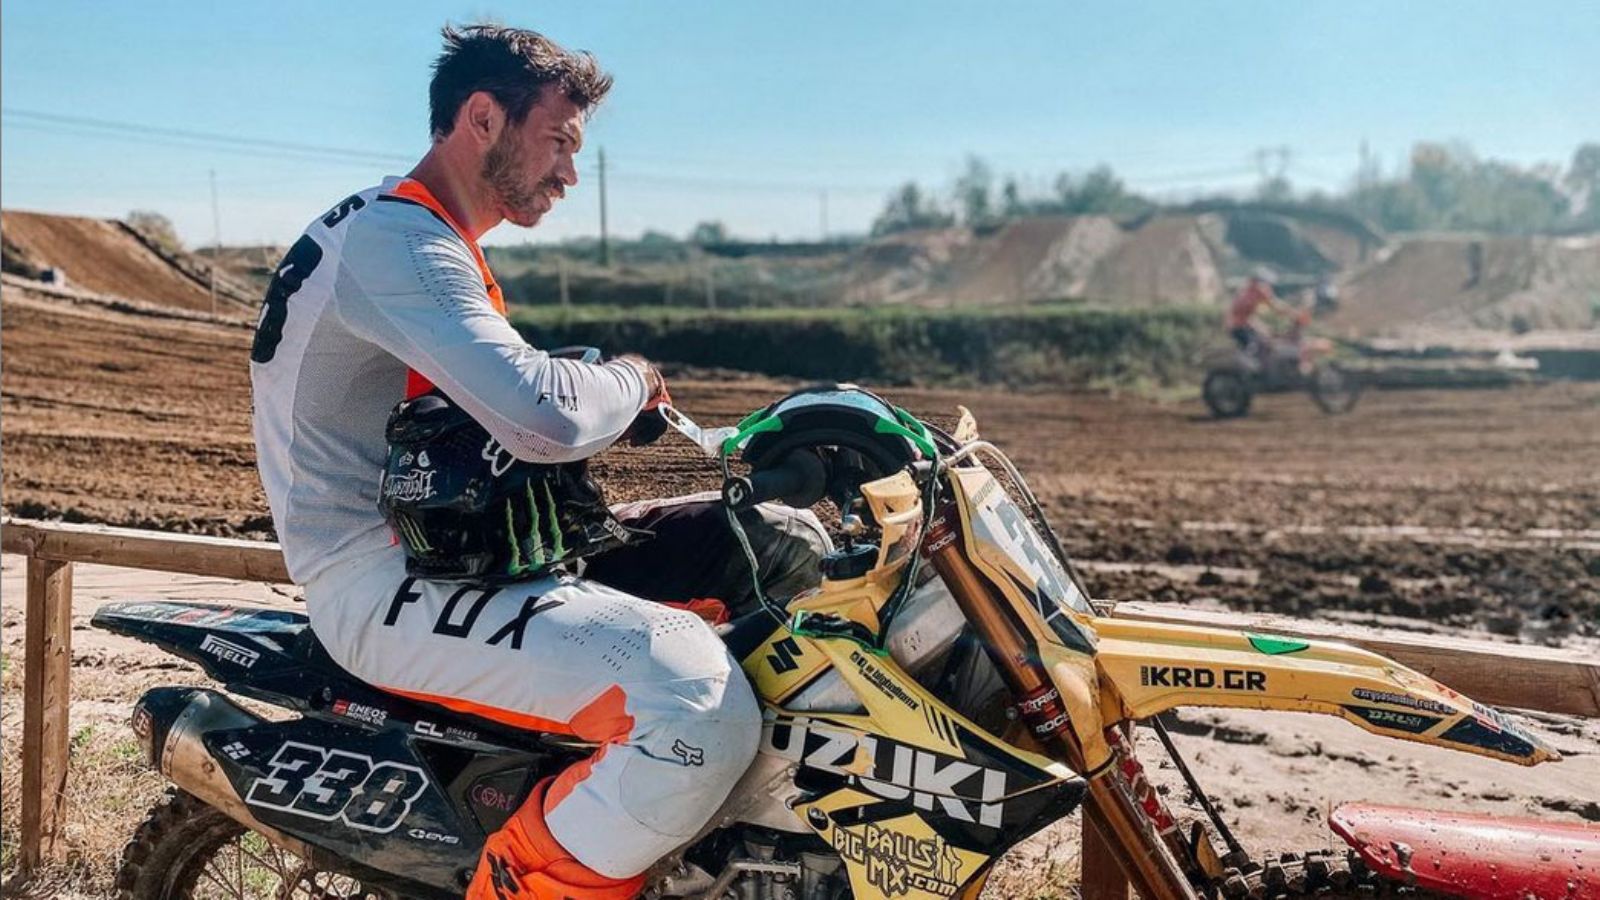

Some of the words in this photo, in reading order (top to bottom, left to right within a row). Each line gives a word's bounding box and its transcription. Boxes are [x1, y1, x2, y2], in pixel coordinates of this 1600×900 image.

[383, 577, 565, 650] FOX
[200, 633, 260, 669] PIRELLI
[1150, 666, 1267, 692] KRD.GR
[346, 711, 371, 724] MOTOR
[348, 703, 388, 720] ENEOS
[414, 720, 443, 738] CL
[446, 727, 478, 740] BRAKES
[245, 741, 429, 834] 338
[762, 715, 1007, 829] UZUKI
[833, 824, 866, 866] BIG
[865, 822, 935, 872] BALLS
